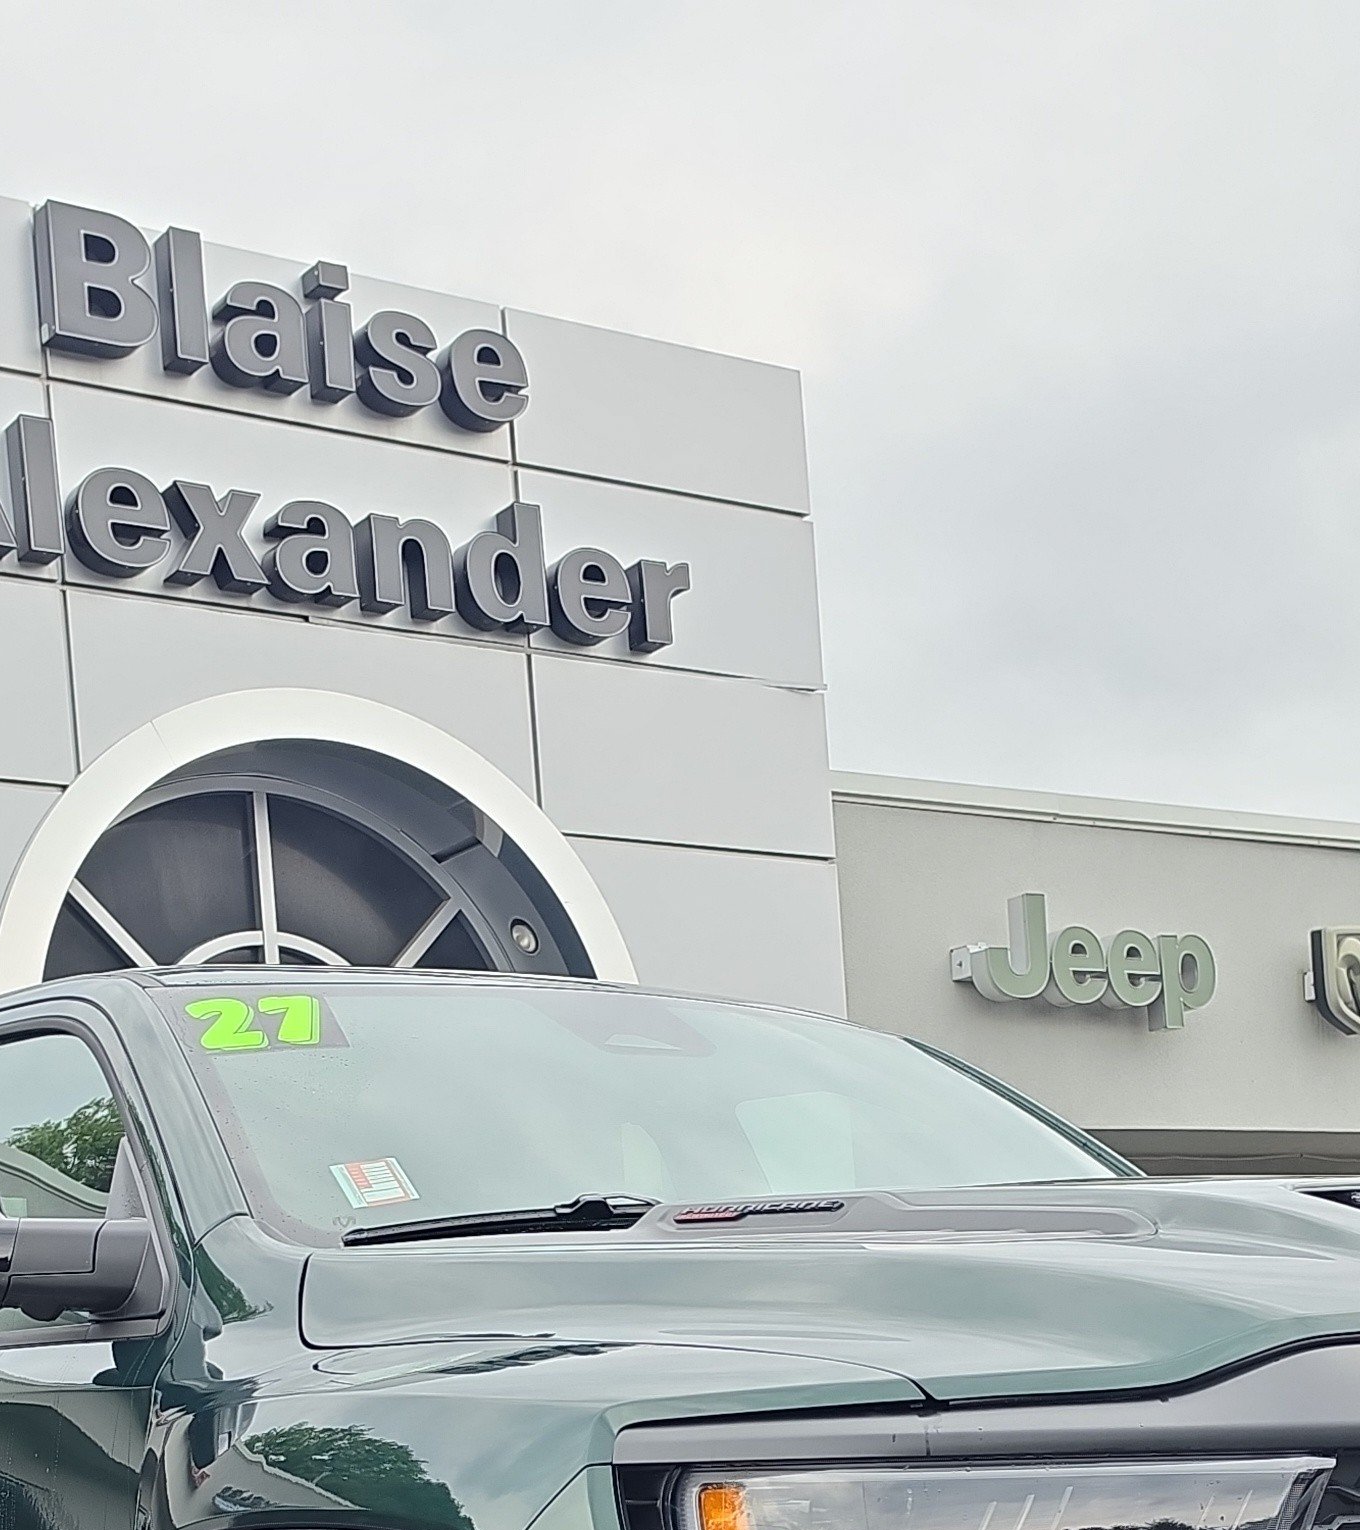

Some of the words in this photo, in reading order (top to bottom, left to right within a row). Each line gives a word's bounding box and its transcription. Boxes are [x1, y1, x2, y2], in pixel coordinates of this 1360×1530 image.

[36, 199, 529, 432] Blaise
[184, 994, 321, 1054] 27
[972, 892, 1217, 1031] Jeep
